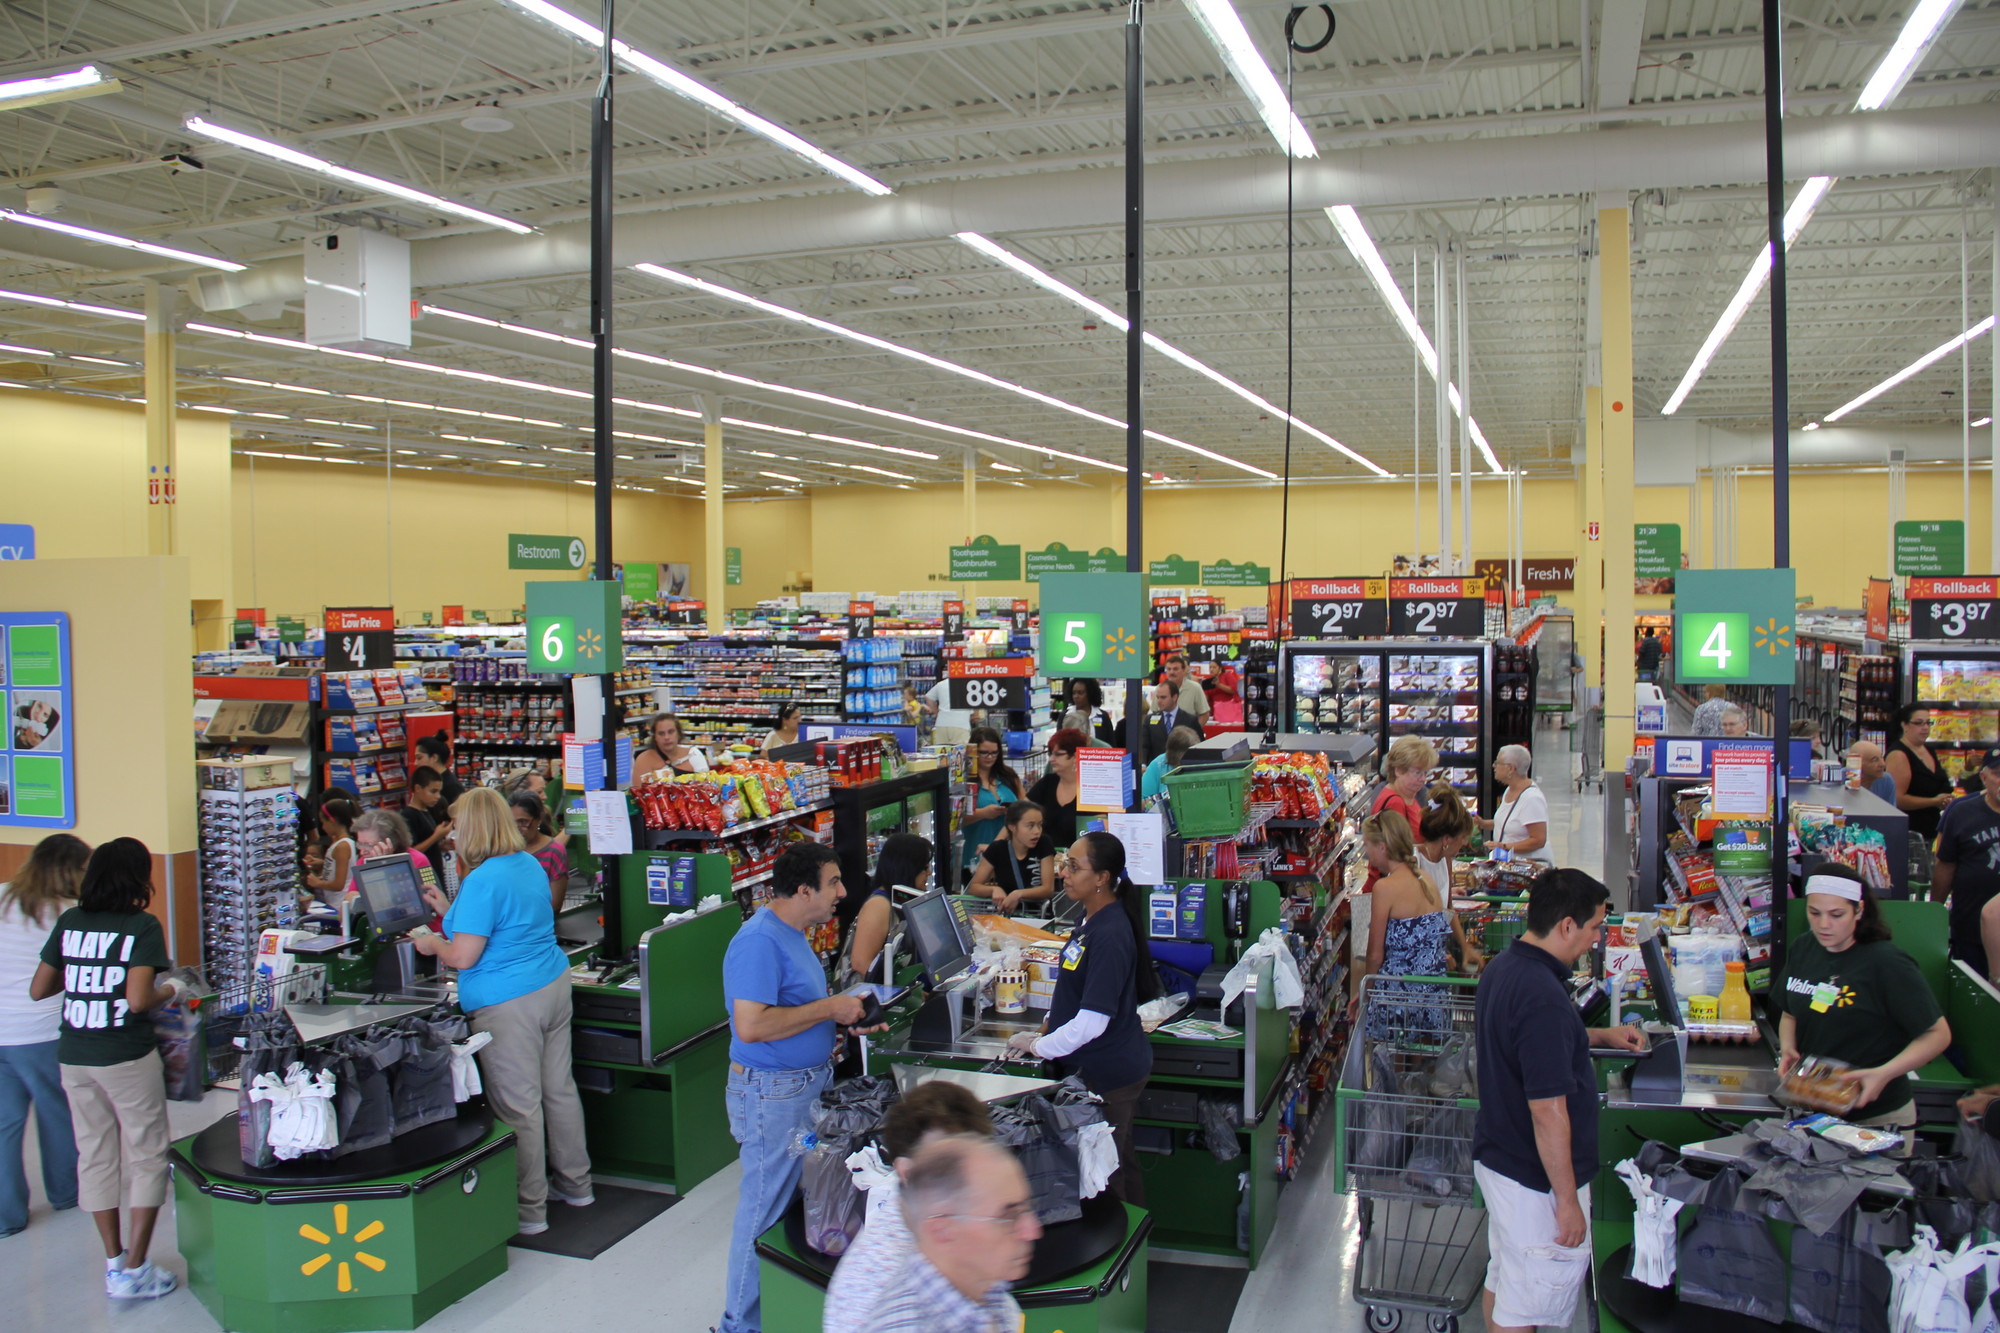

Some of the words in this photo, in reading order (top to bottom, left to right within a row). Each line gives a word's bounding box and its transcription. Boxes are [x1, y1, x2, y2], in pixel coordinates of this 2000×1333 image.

[517, 543, 561, 559] Restroom
[952, 549, 989, 557] Toothpaste
[1527, 567, 1561, 580] Fresh
[1311, 583, 1361, 594] Rollback
[1408, 581, 1458, 593] Rollback
[1933, 582, 1991, 593] Rollback
[342, 618, 359, 629] Low
[360, 617, 381, 628] Price
[542, 622, 564, 662] 6
[1062, 620, 1086, 664] 5
[1699, 621, 1732, 669] 4
[342, 635, 366, 668] $4
[965, 666, 984, 675] Low
[985, 664, 1008, 674] Price
[1718, 742, 1734, 750] Find
[62, 929, 119, 959] MAY
[120, 934, 135, 962] I
[64, 963, 126, 993] HELP
